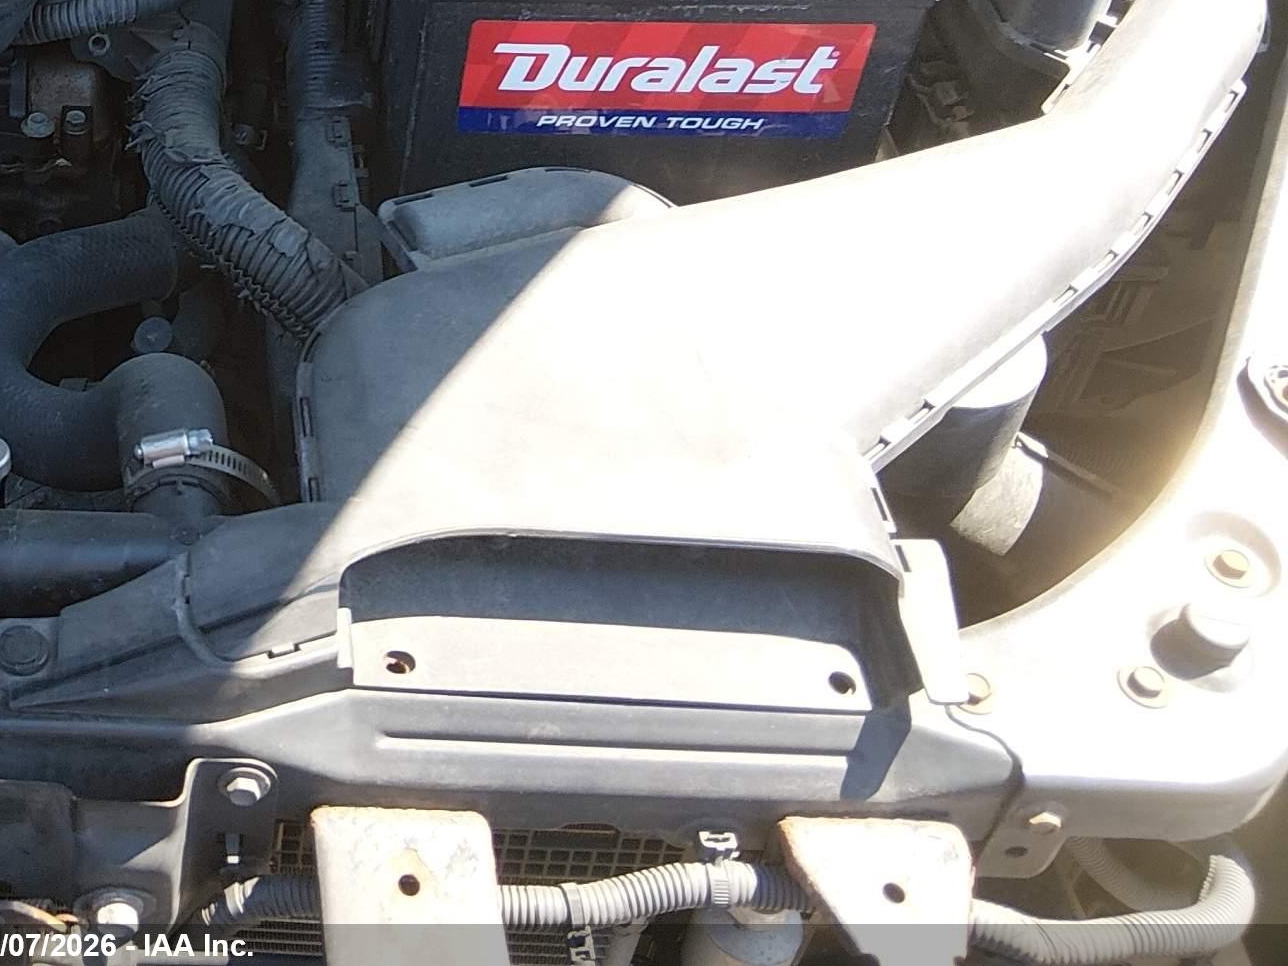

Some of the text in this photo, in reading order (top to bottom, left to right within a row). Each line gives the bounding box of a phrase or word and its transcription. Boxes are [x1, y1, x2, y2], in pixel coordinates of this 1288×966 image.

[493, 43, 839, 95] Duralast
[536, 115, 765, 132] PROVEN TOUGH
